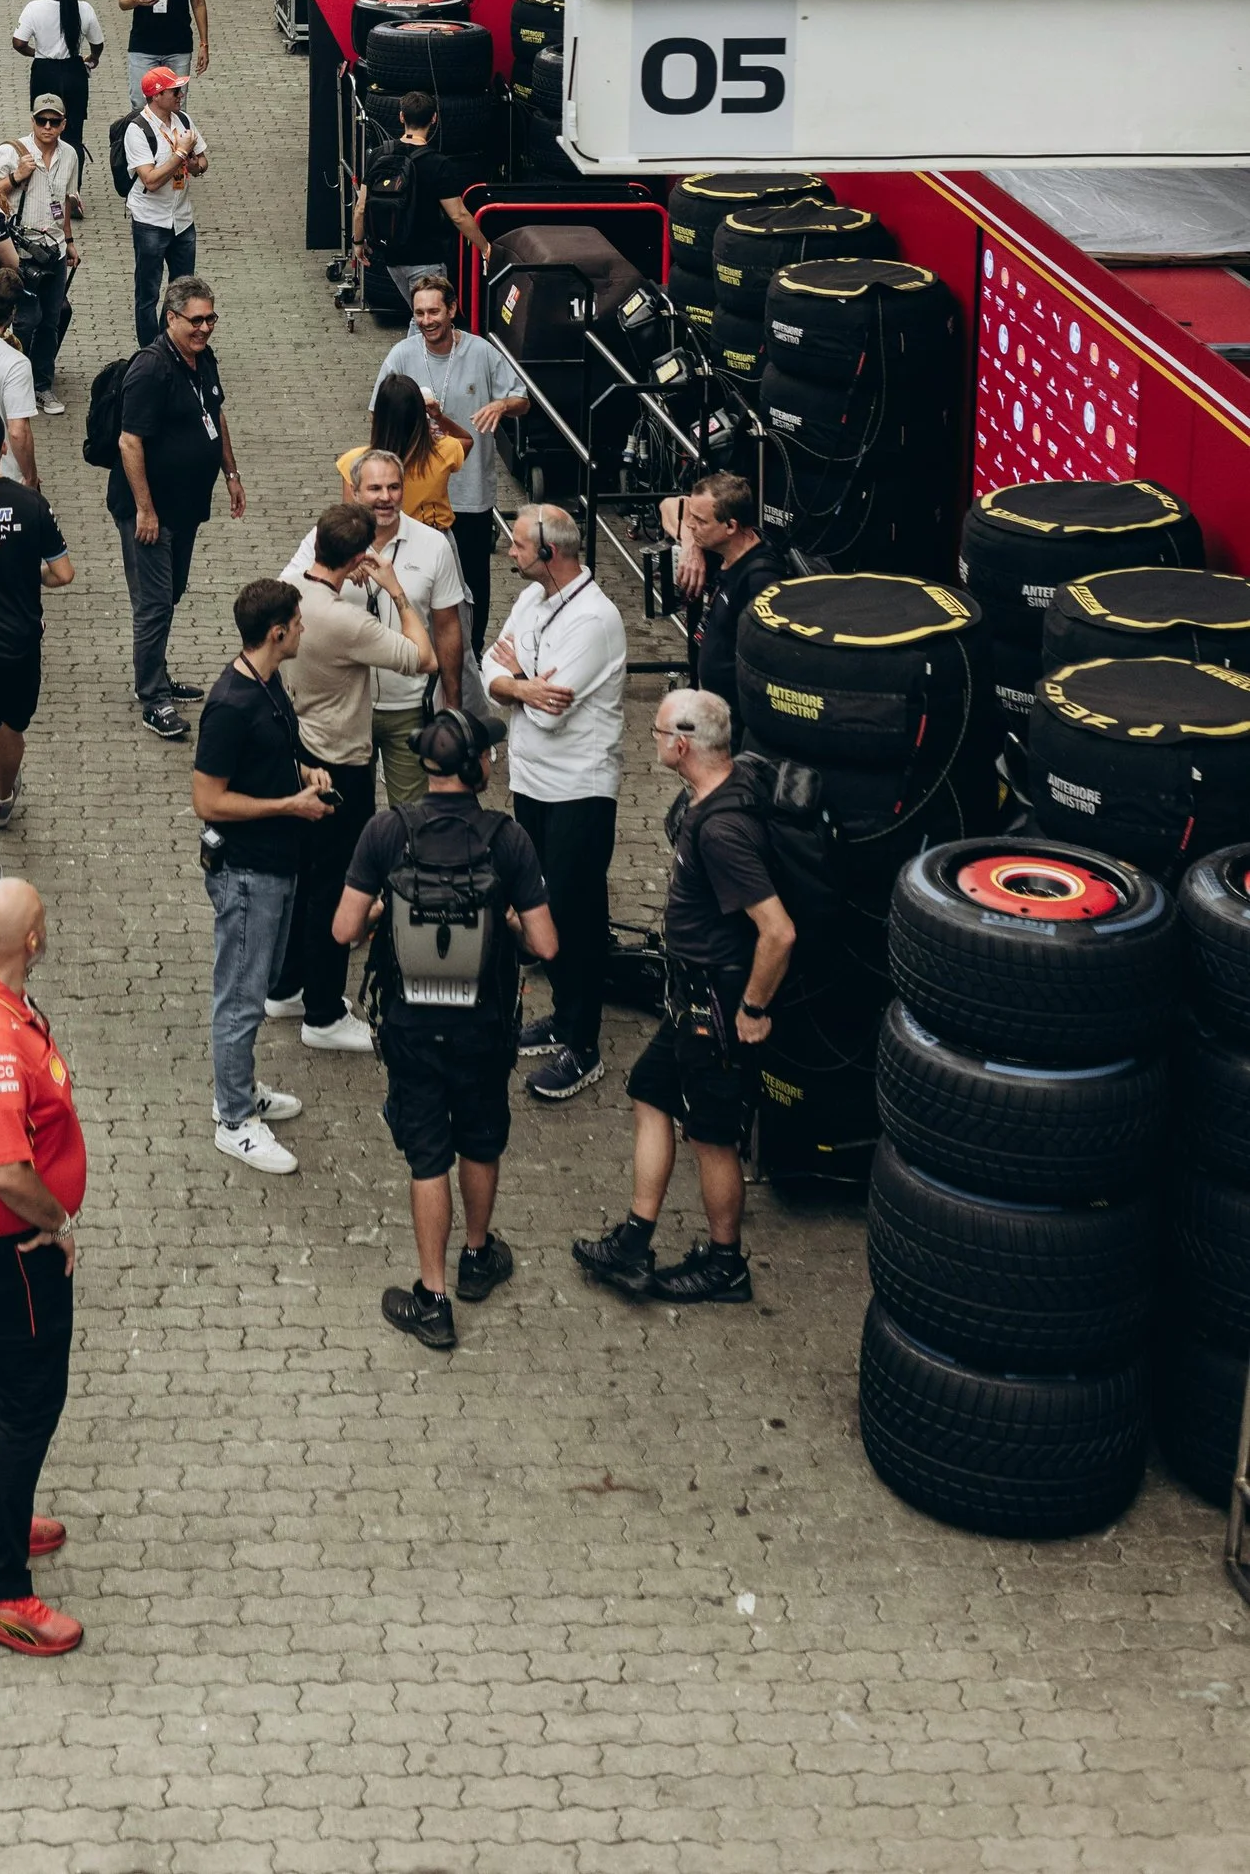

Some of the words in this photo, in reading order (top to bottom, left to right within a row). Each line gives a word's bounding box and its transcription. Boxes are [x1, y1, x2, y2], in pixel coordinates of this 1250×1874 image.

[641, 37, 787, 115] 05
[672, 223, 696, 238] ANTERIORE
[717, 263, 743, 279] ANTERIORE
[771, 320, 804, 338] ANTERIORE
[773, 329, 800, 345] SINISTRO
[723, 348, 756, 364] ANTERIORE
[727, 358, 751, 371] DESTRO
[769, 406, 802, 426] ANTERIORE
[772, 417, 795, 432] DESTRO
[753, 585, 790, 629] ZERO
[921, 586, 972, 618] PIRELLI
[766, 682, 825, 710] ANTERIORE
[1044, 682, 1119, 730] ZERO
[770, 697, 819, 721] SINISTRO
[1047, 772, 1102, 805] ANTERIORE
[1051, 788, 1096, 816] SINISTRO
[766, 1084, 791, 1107] STRO
